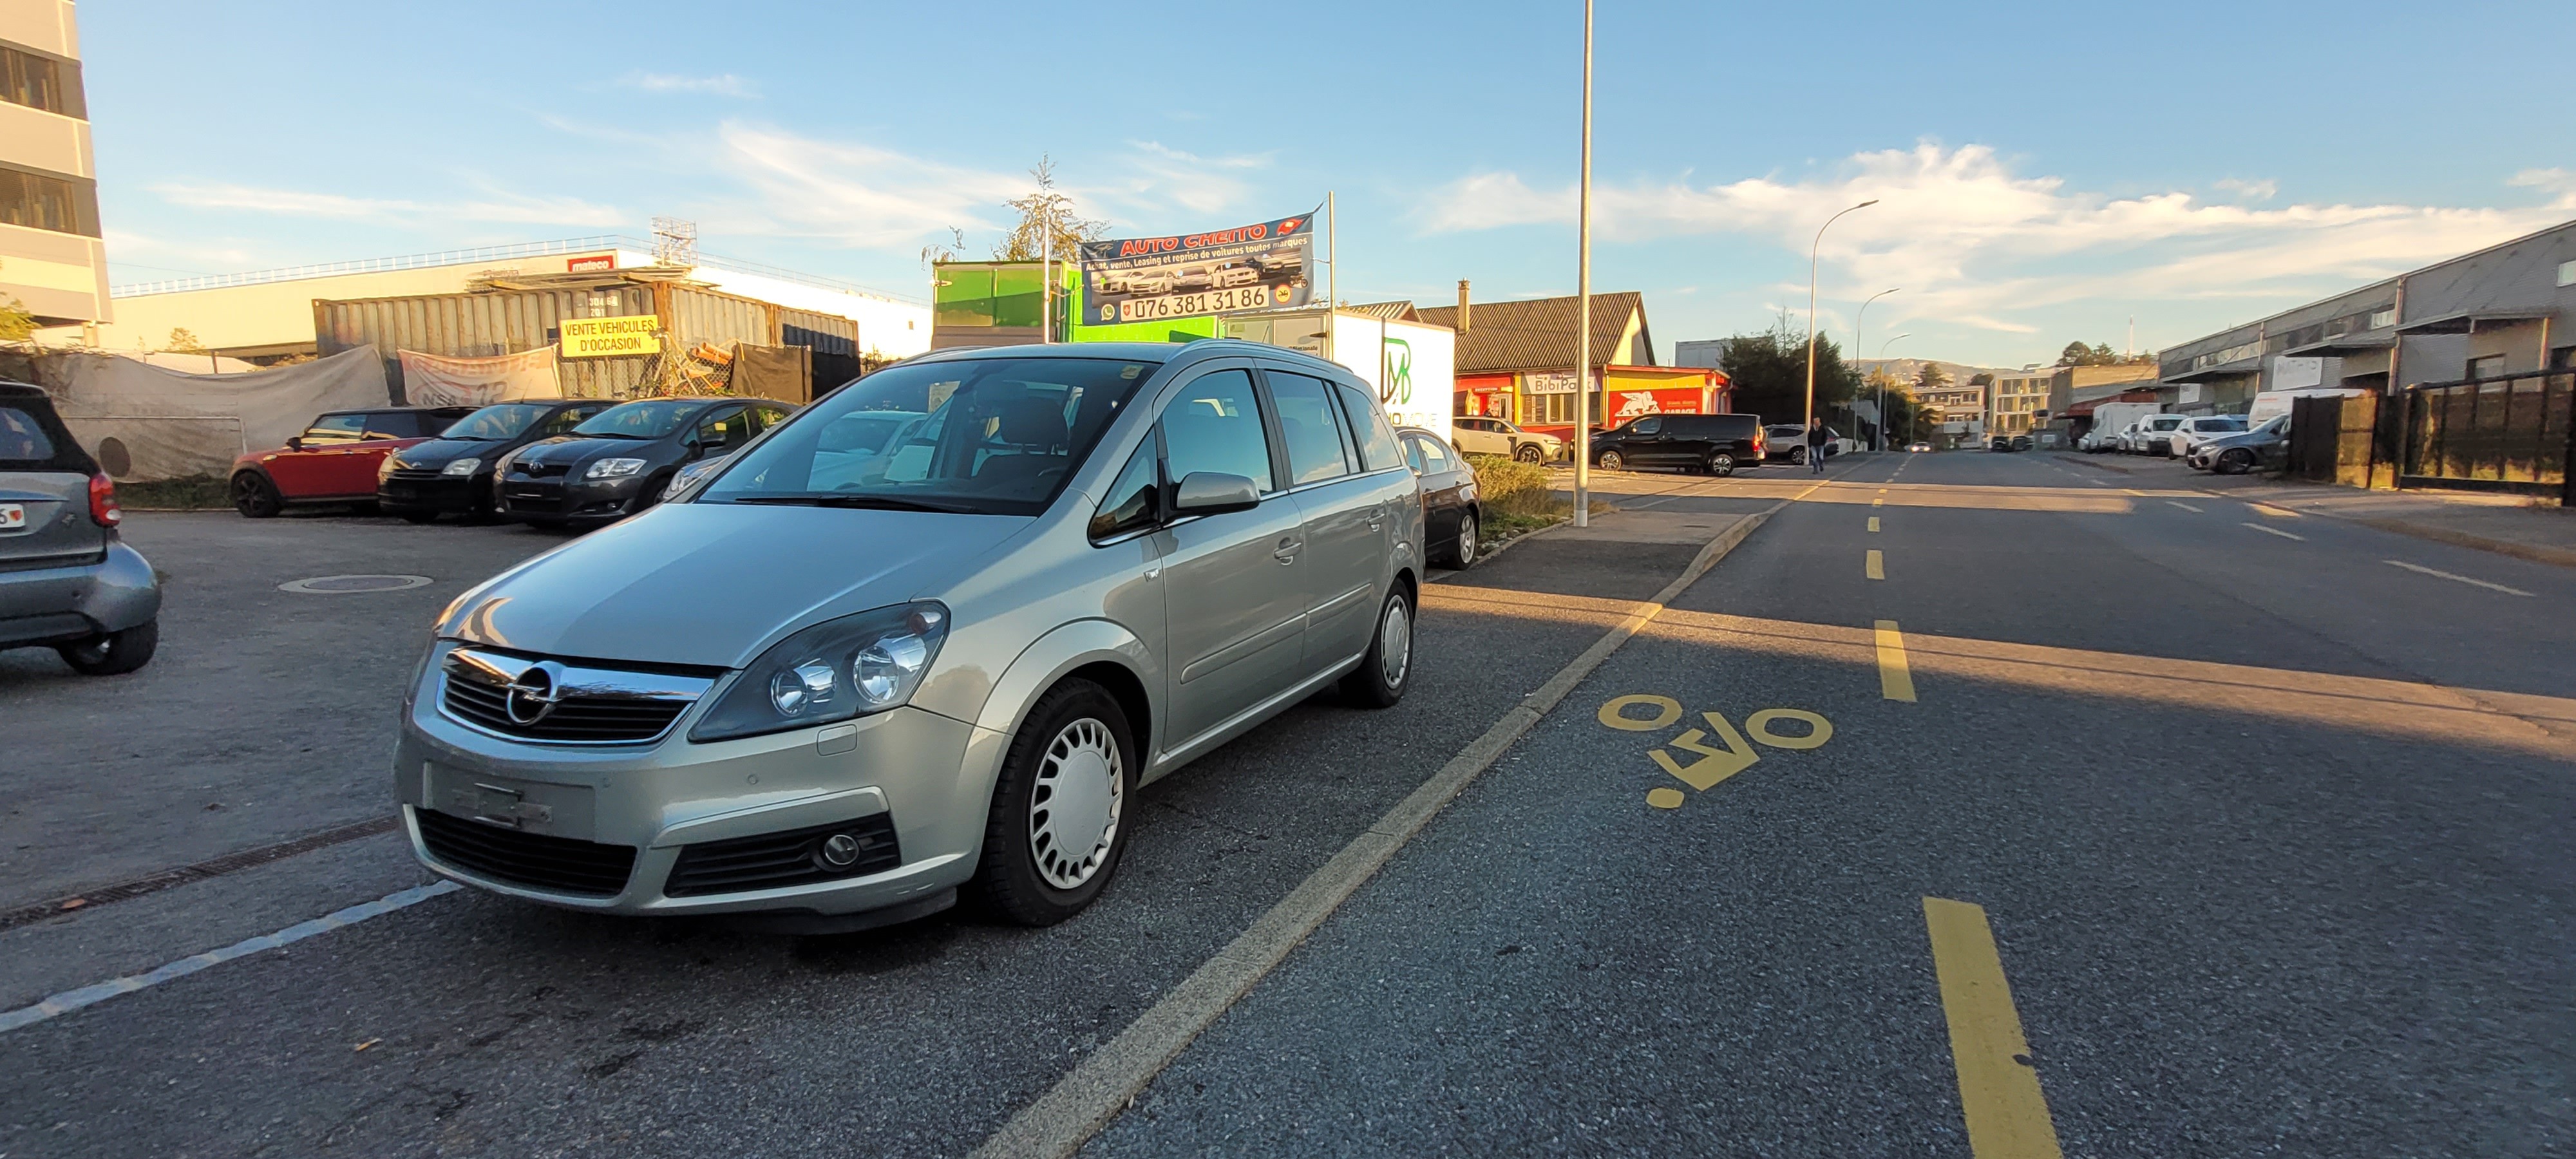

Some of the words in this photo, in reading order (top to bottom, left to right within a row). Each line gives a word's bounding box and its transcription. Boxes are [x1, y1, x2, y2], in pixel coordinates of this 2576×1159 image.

[1120, 237, 1179, 256] AUTO
[1184, 224, 1267, 248] CHEITO
[1110, 261, 1133, 269] vente,
[1133, 256, 1161, 267] Leasing
[1163, 254, 1171, 263] et
[1172, 252, 1198, 263] reprise
[1200, 250, 1210, 259] de
[1211, 247, 1244, 257] voitures
[1245, 243, 1271, 254] toutes
[1273, 237, 1308, 249] marques
[573, 260, 609, 272] mateco
[1135, 298, 1168, 317] 076
[1173, 294, 1208, 314] 381
[1213, 291, 1236, 310] 31
[1241, 288, 1264, 306] 86
[565, 323, 597, 335] VENTE
[599, 319, 654, 334] VEHICULES
[580, 337, 641, 352] D'OCCASION
[1535, 378, 1591, 391] BibiPak
